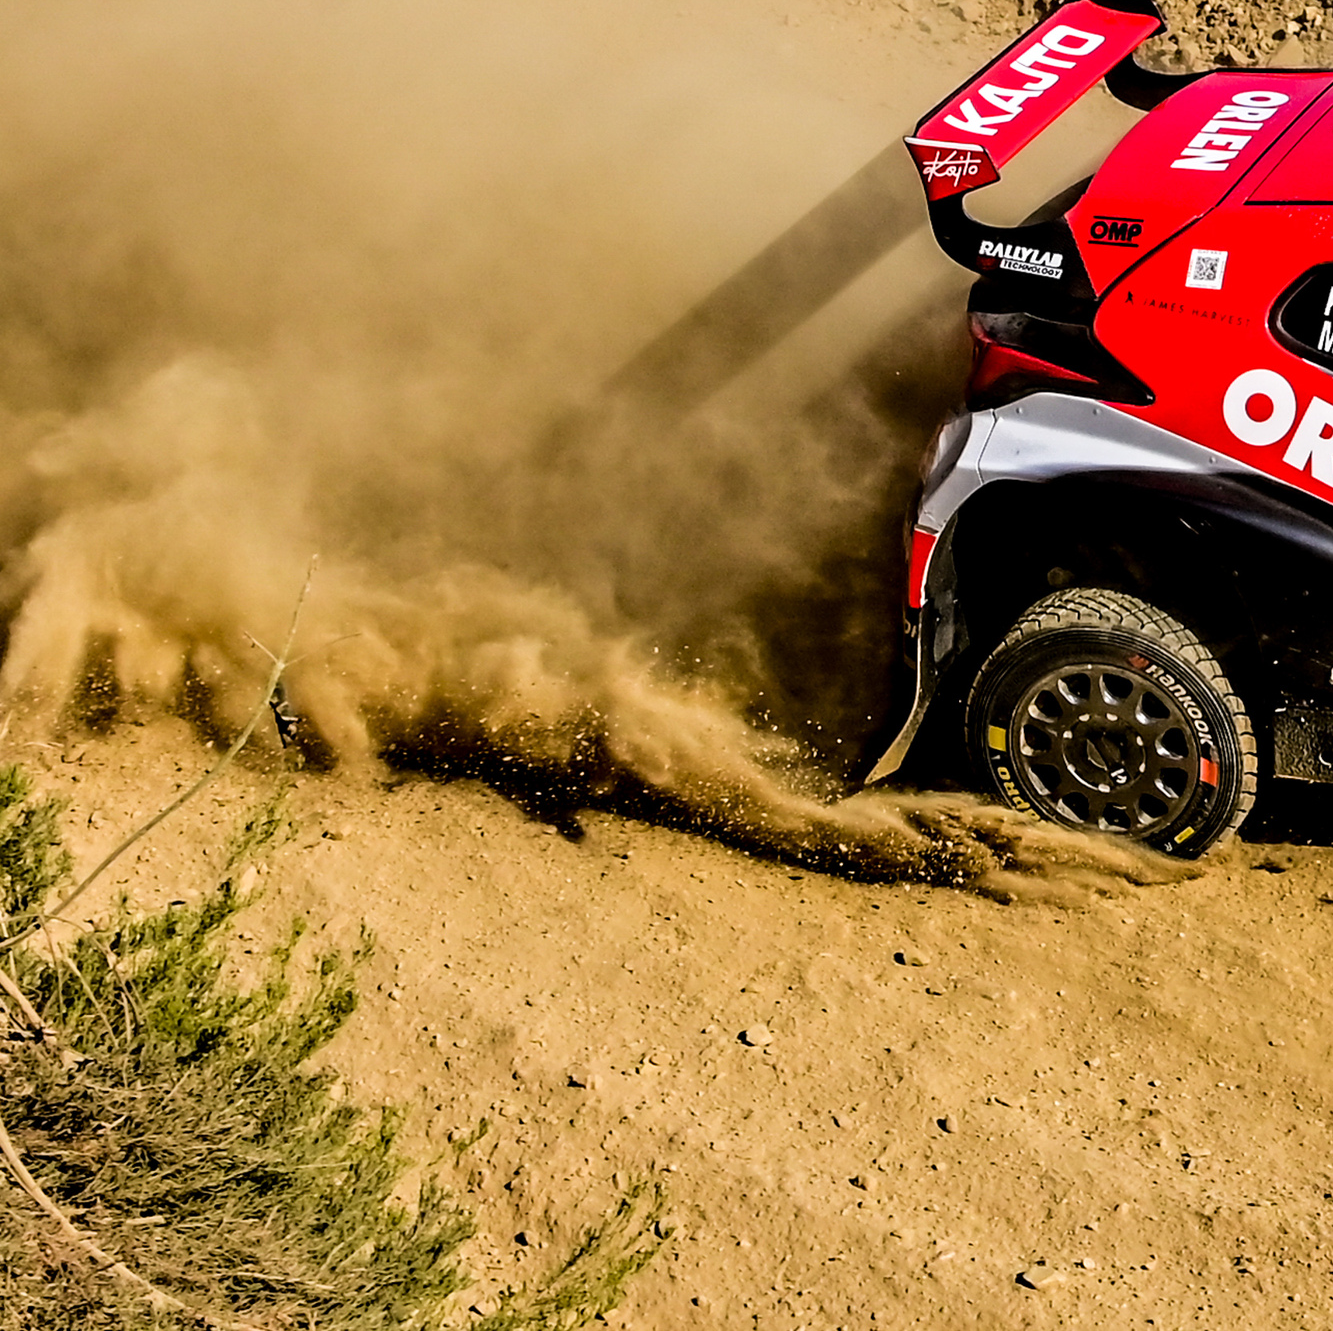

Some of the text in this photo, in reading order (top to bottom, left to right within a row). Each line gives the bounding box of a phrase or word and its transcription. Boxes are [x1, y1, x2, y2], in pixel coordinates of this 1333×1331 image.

[943, 24, 1106, 137] KAJTO
[1170, 89, 1290, 172] ORLEN
[1090, 220, 1143, 242] OMP
[979, 240, 1064, 269] RALLYLAB
[1001, 259, 1062, 279] TECHNOLOGY
[1191, 309, 1251, 329] HARVEST
